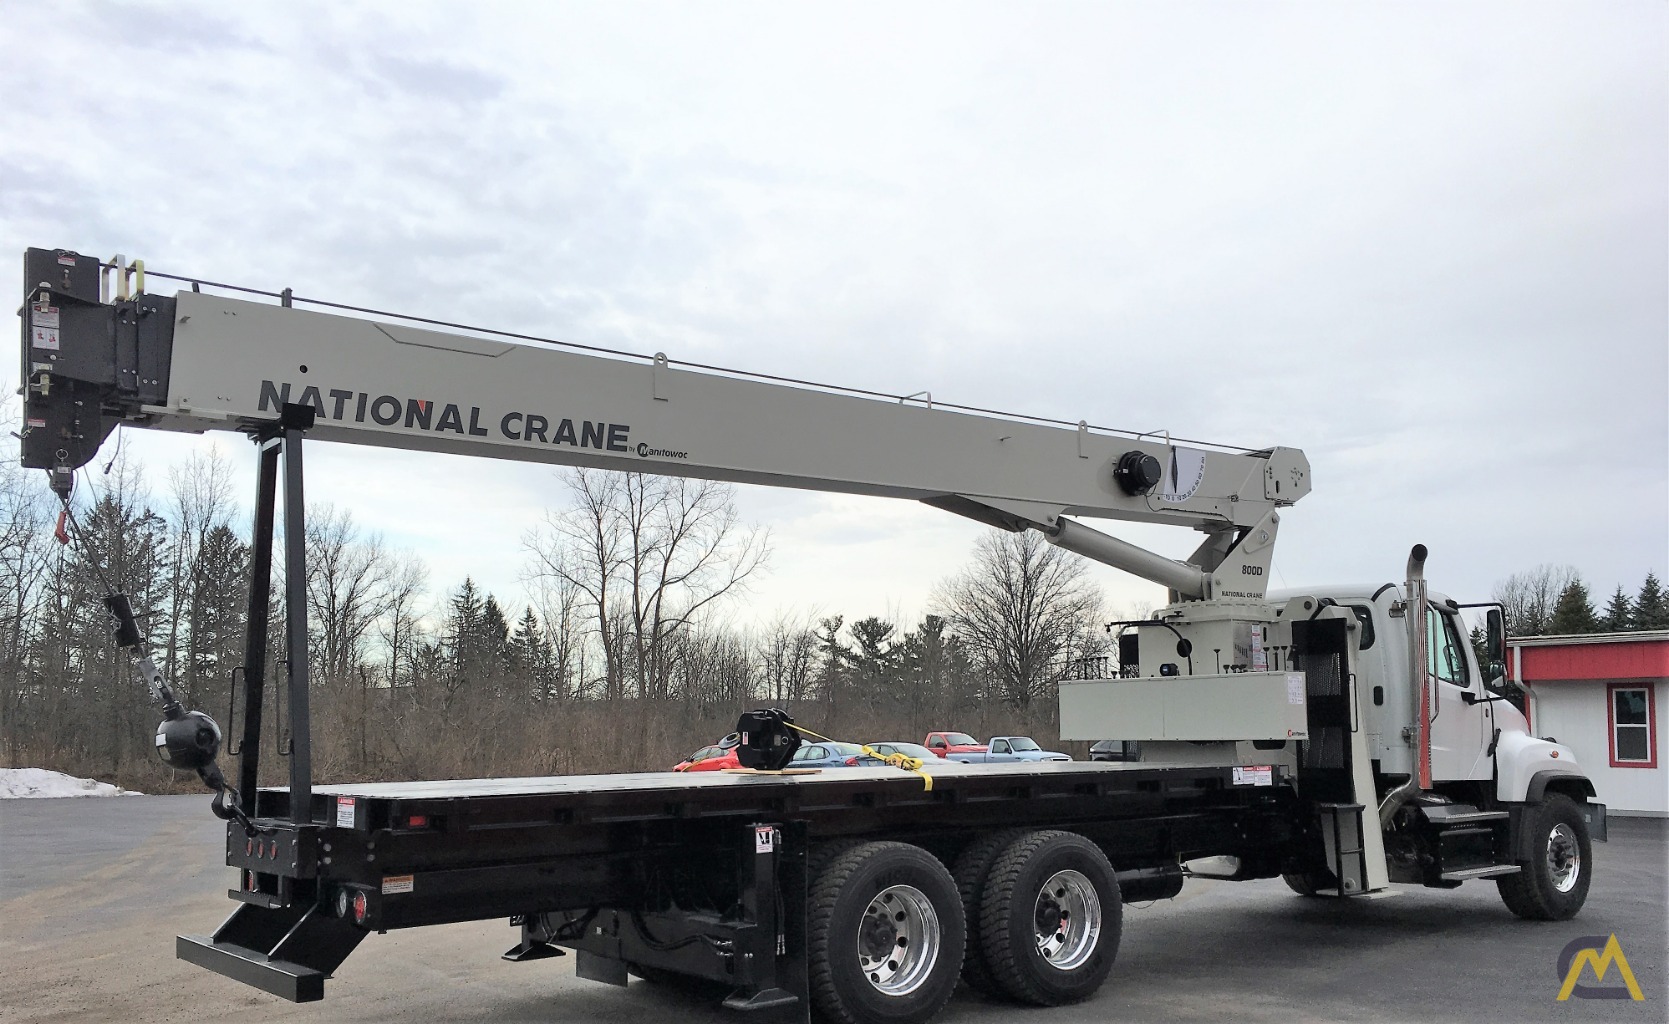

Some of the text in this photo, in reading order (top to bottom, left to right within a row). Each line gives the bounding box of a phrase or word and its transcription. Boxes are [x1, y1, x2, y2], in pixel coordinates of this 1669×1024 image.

[257, 379, 630, 452] NATIONAL CRANE
[636, 442, 689, 459] Manitowoc
[1241, 564, 1263, 576] 800D
[1221, 590, 1246, 598] NATIONAL
